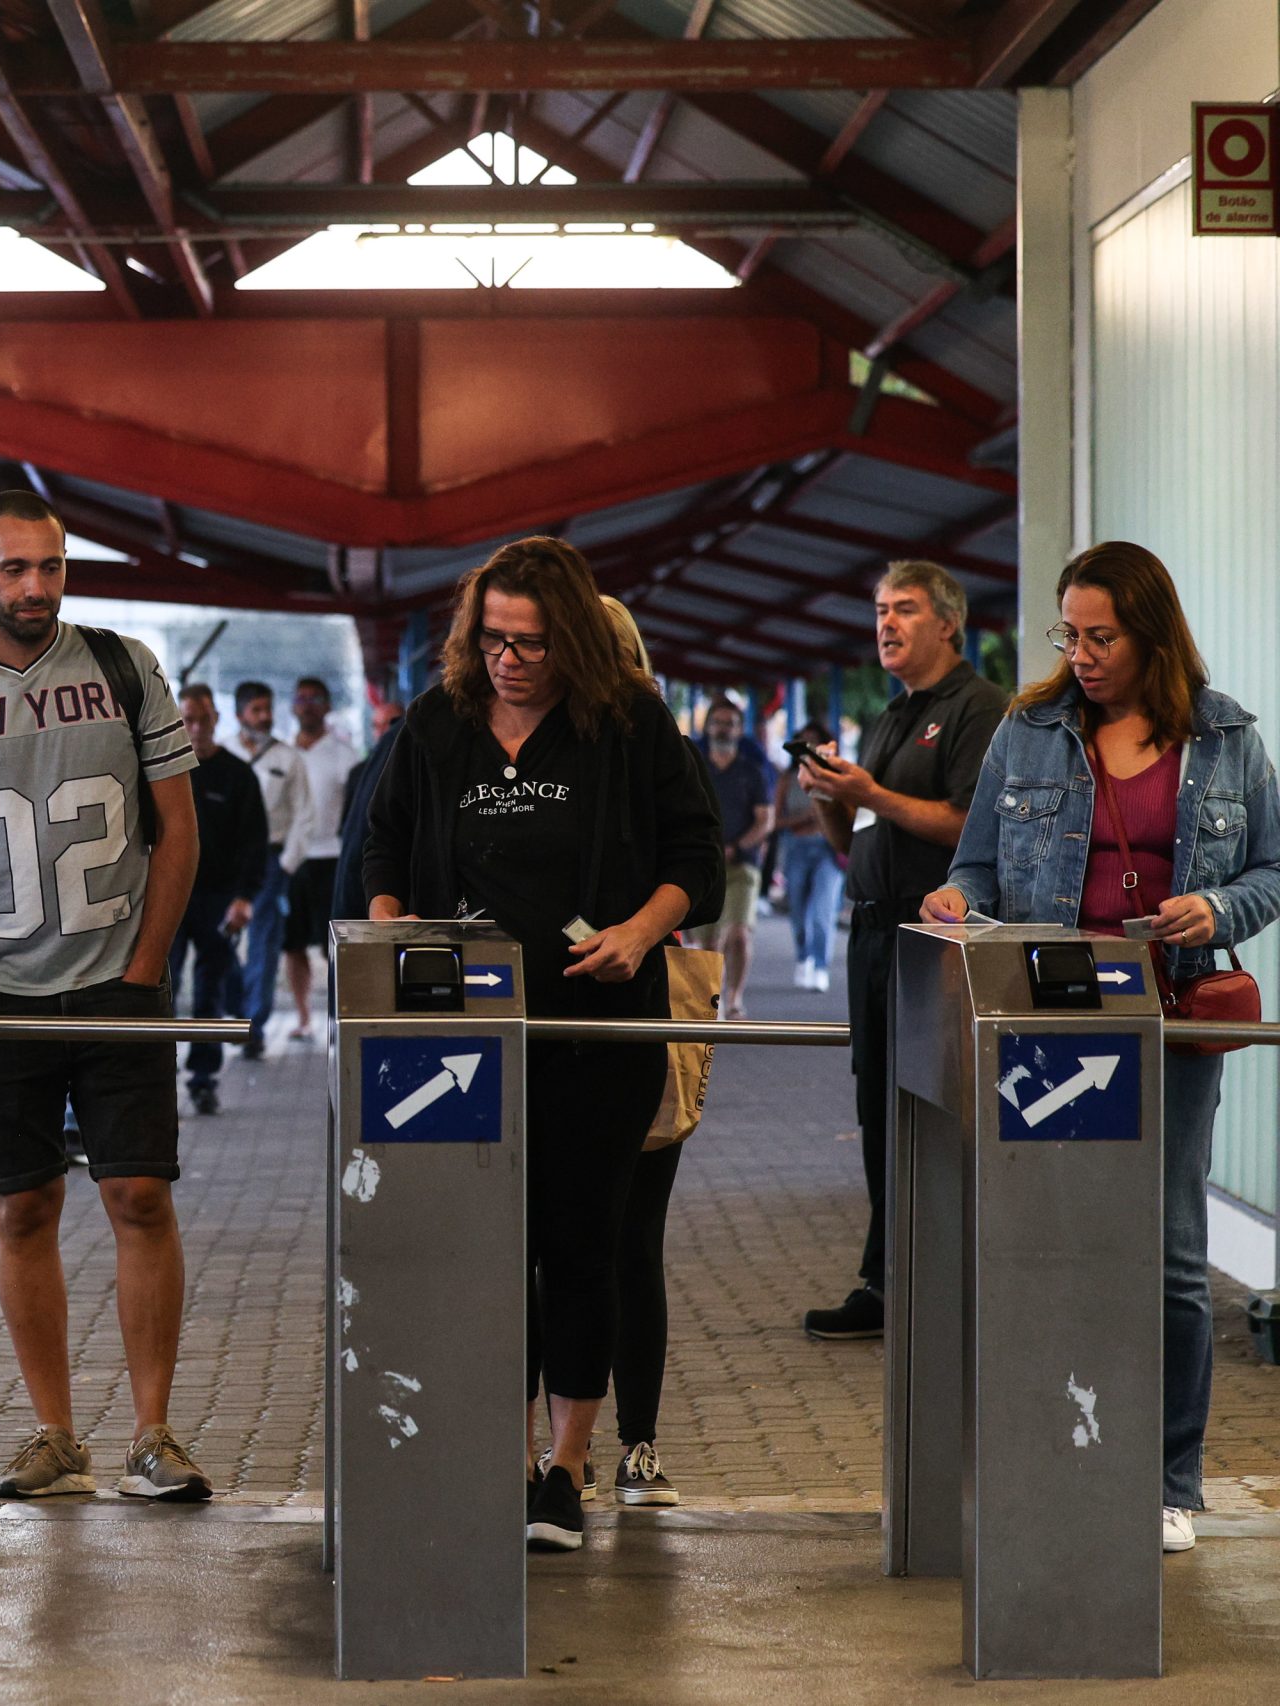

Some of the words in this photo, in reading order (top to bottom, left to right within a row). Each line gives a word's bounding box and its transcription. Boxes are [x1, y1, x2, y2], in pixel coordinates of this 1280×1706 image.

[1218, 195, 1257, 207] Botão
[1205, 212, 1221, 223] de
[1226, 212, 1269, 223] alarme
[459, 780, 570, 809] ELEGANCE
[495, 799, 516, 808] WHEN
[478, 807, 498, 815] LESS
[512, 804, 535, 813] MORE
